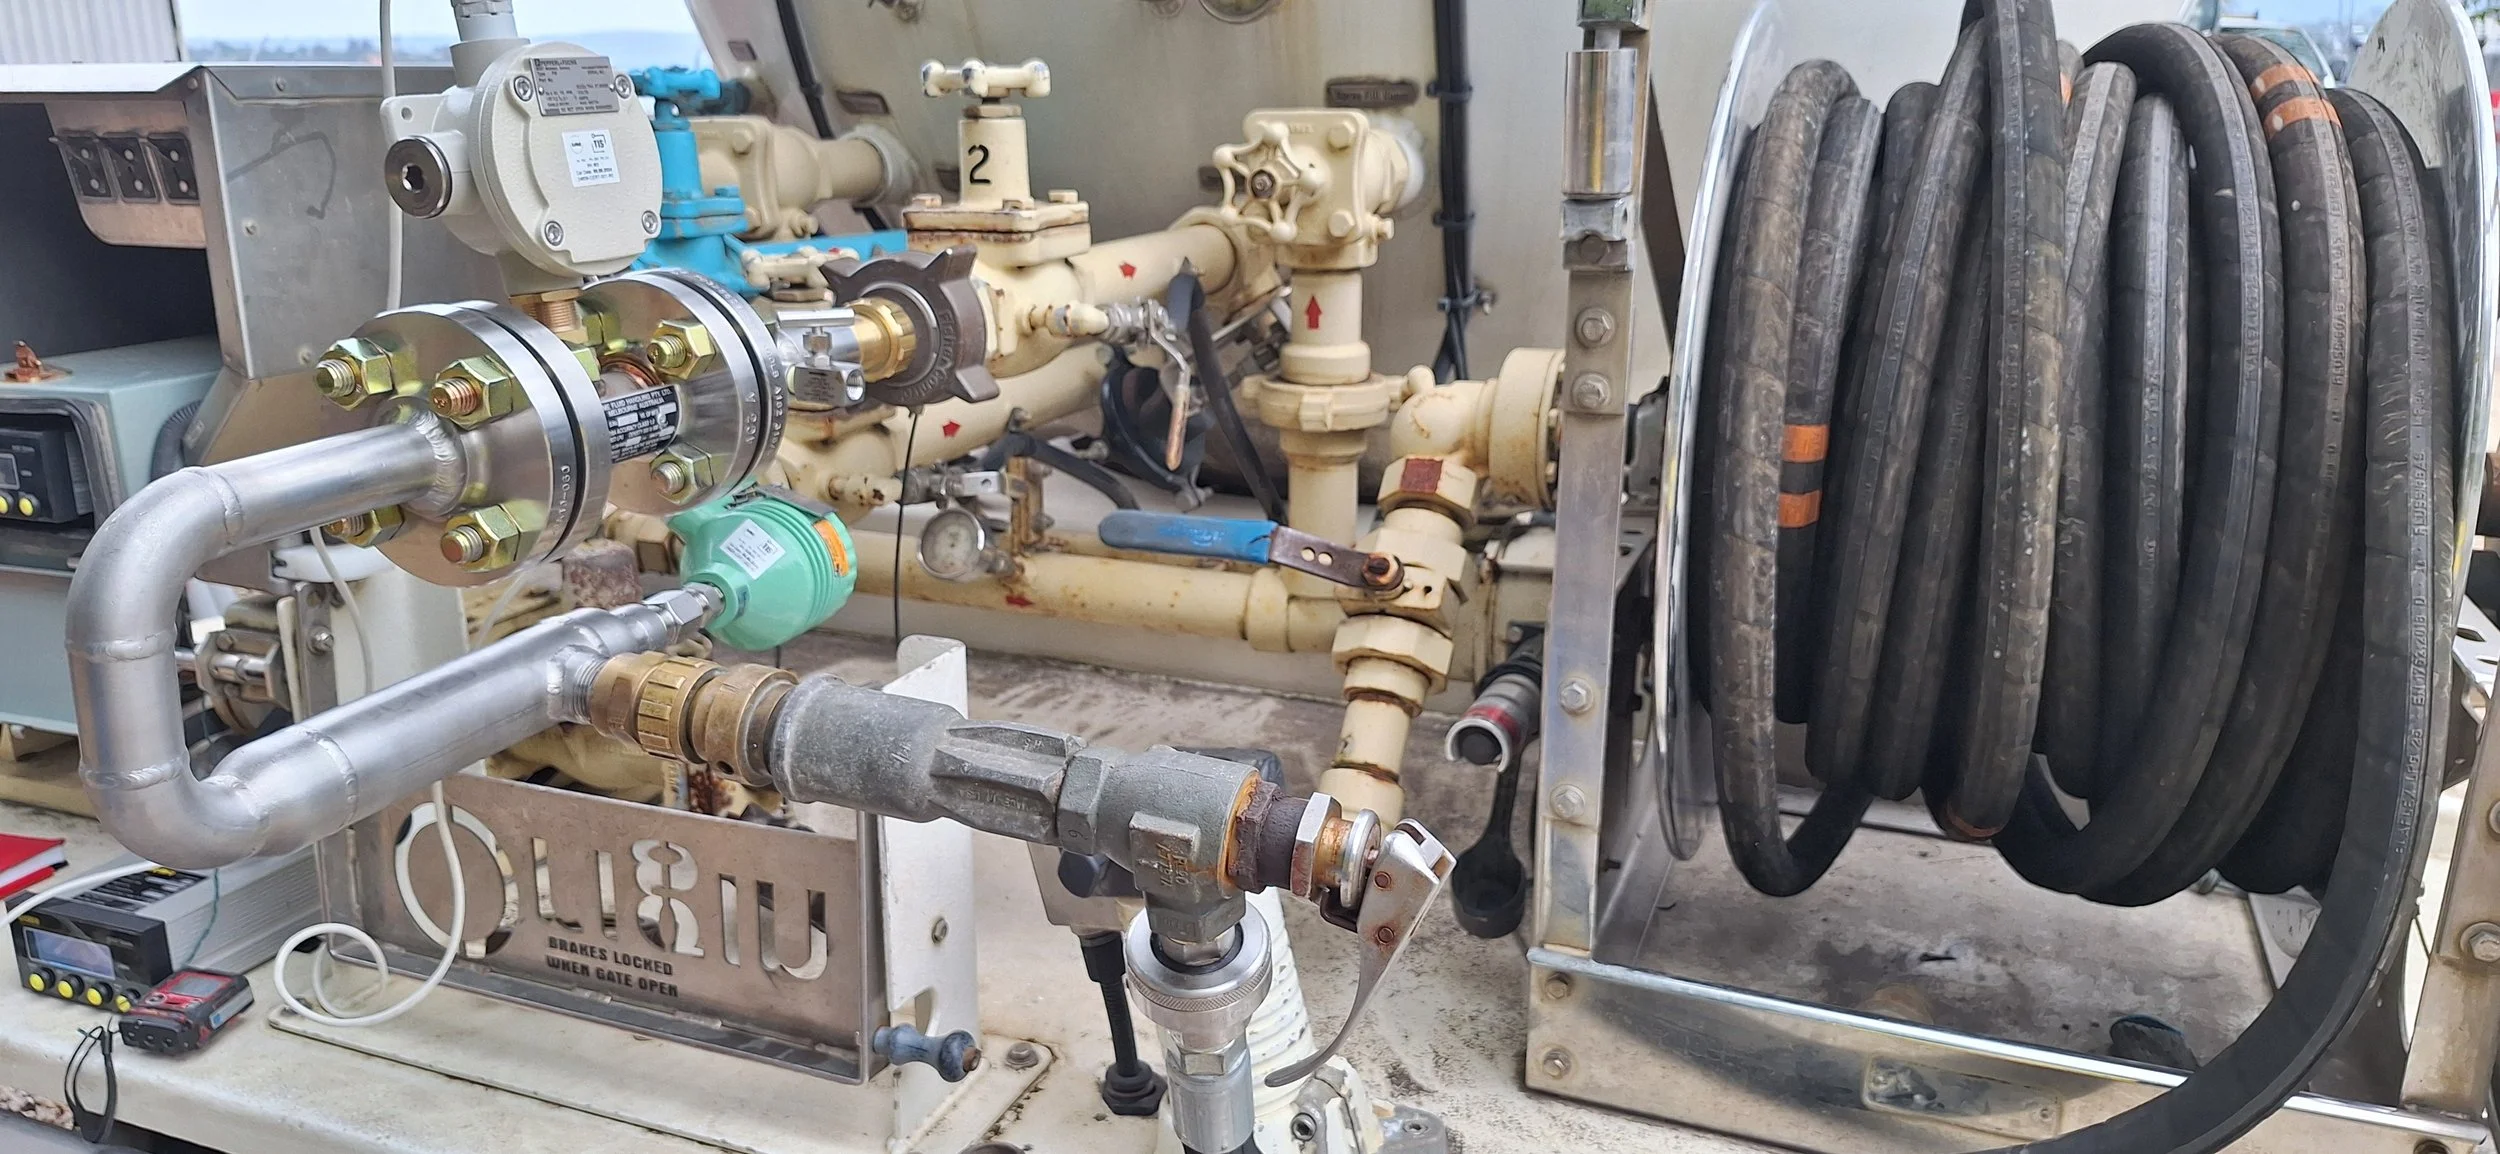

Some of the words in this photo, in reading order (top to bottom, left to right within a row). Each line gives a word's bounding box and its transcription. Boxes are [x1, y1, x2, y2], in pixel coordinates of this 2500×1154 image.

[967, 144, 992, 184] 2
[546, 954, 590, 977] WHEN
[595, 966, 633, 988] GATE
[638, 977, 679, 997] OPEN
[548, 936, 608, 961] BRAKES
[613, 950, 673, 976] LOCKED
